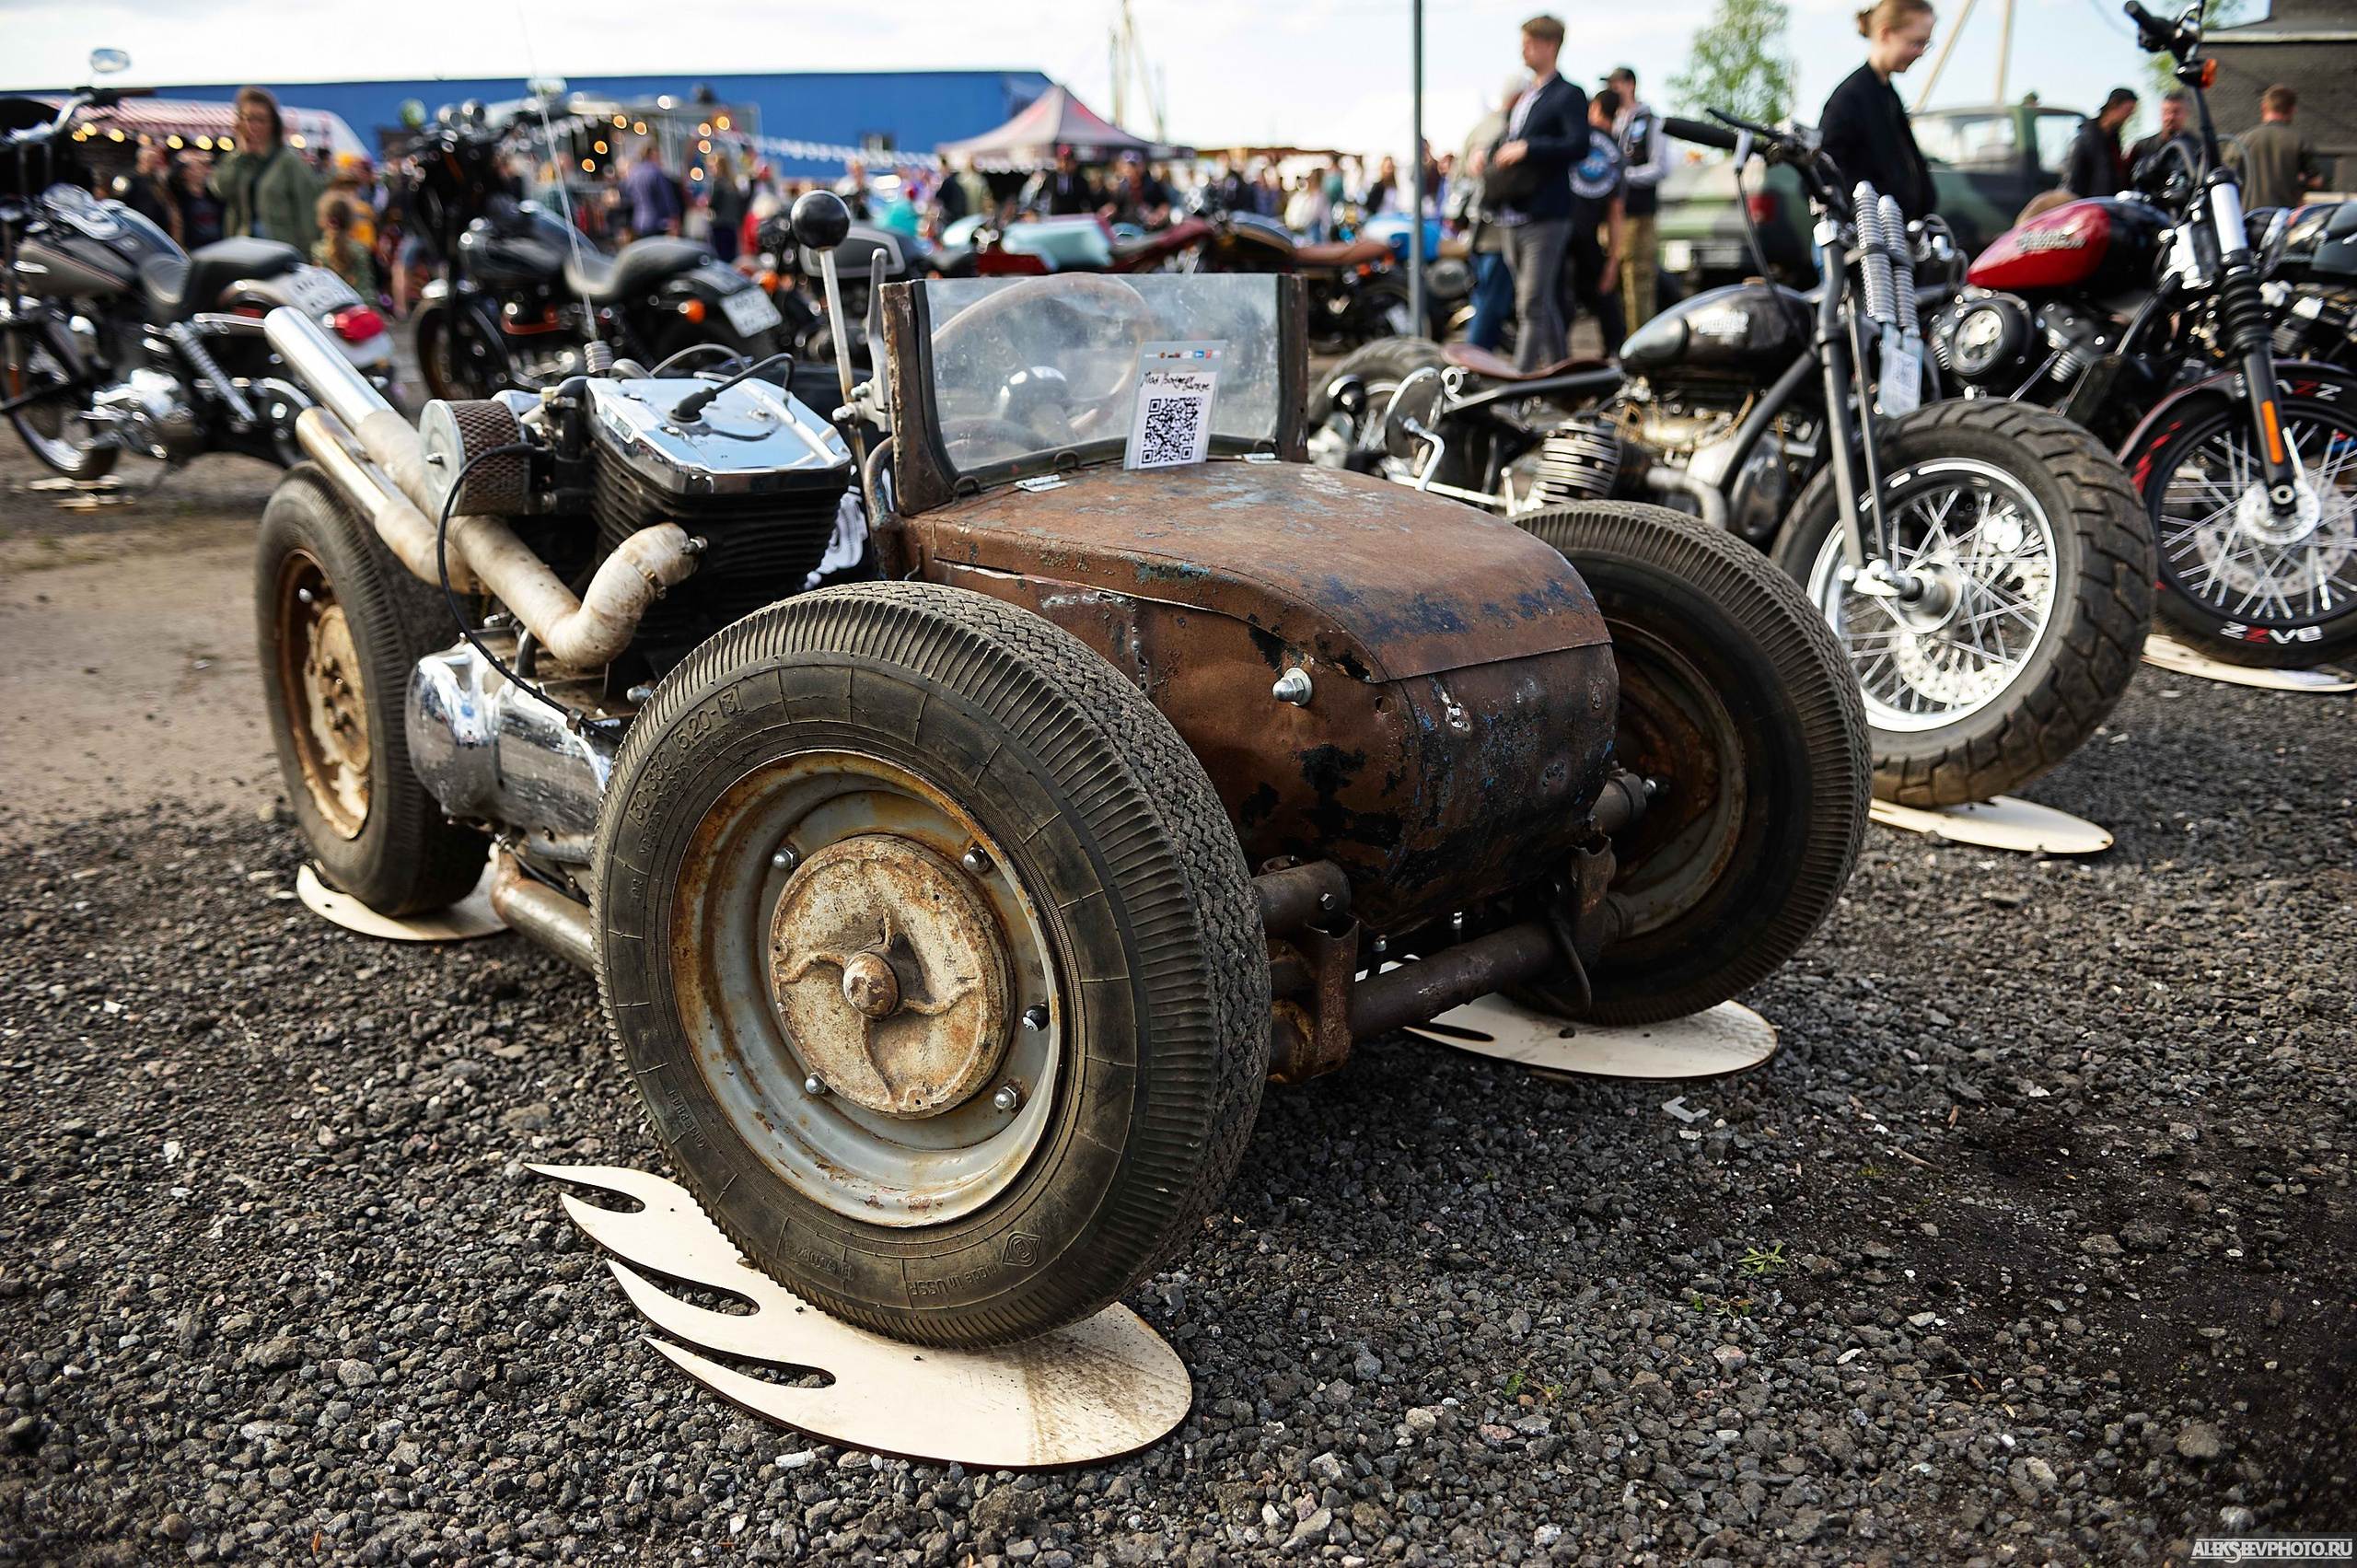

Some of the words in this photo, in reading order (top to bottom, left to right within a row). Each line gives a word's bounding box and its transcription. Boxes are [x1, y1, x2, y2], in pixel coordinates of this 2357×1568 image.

[2274, 379, 2342, 401] AZZ
[628, 749, 672, 826] 130-330
[949, 1274, 964, 1289] in
[966, 1261, 998, 1285] made
[909, 1279, 947, 1296] USSR
